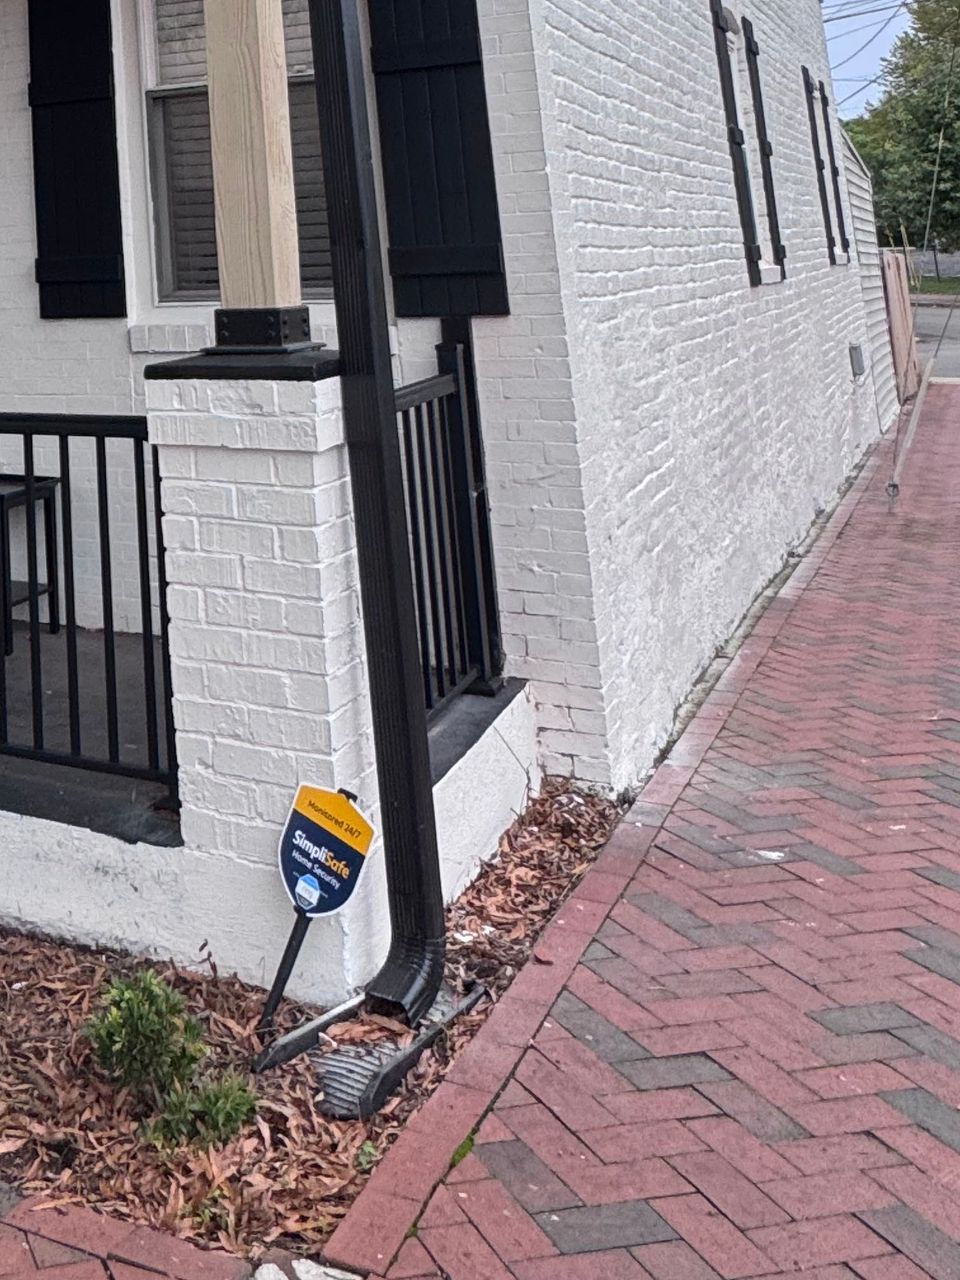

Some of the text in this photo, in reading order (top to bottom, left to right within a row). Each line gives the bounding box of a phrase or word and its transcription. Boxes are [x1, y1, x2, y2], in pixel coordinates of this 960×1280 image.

[307, 800, 362, 839] Monitored 24/7
[292, 830, 350, 879] SimpliSafe
[292, 849, 341, 890] Home Security
